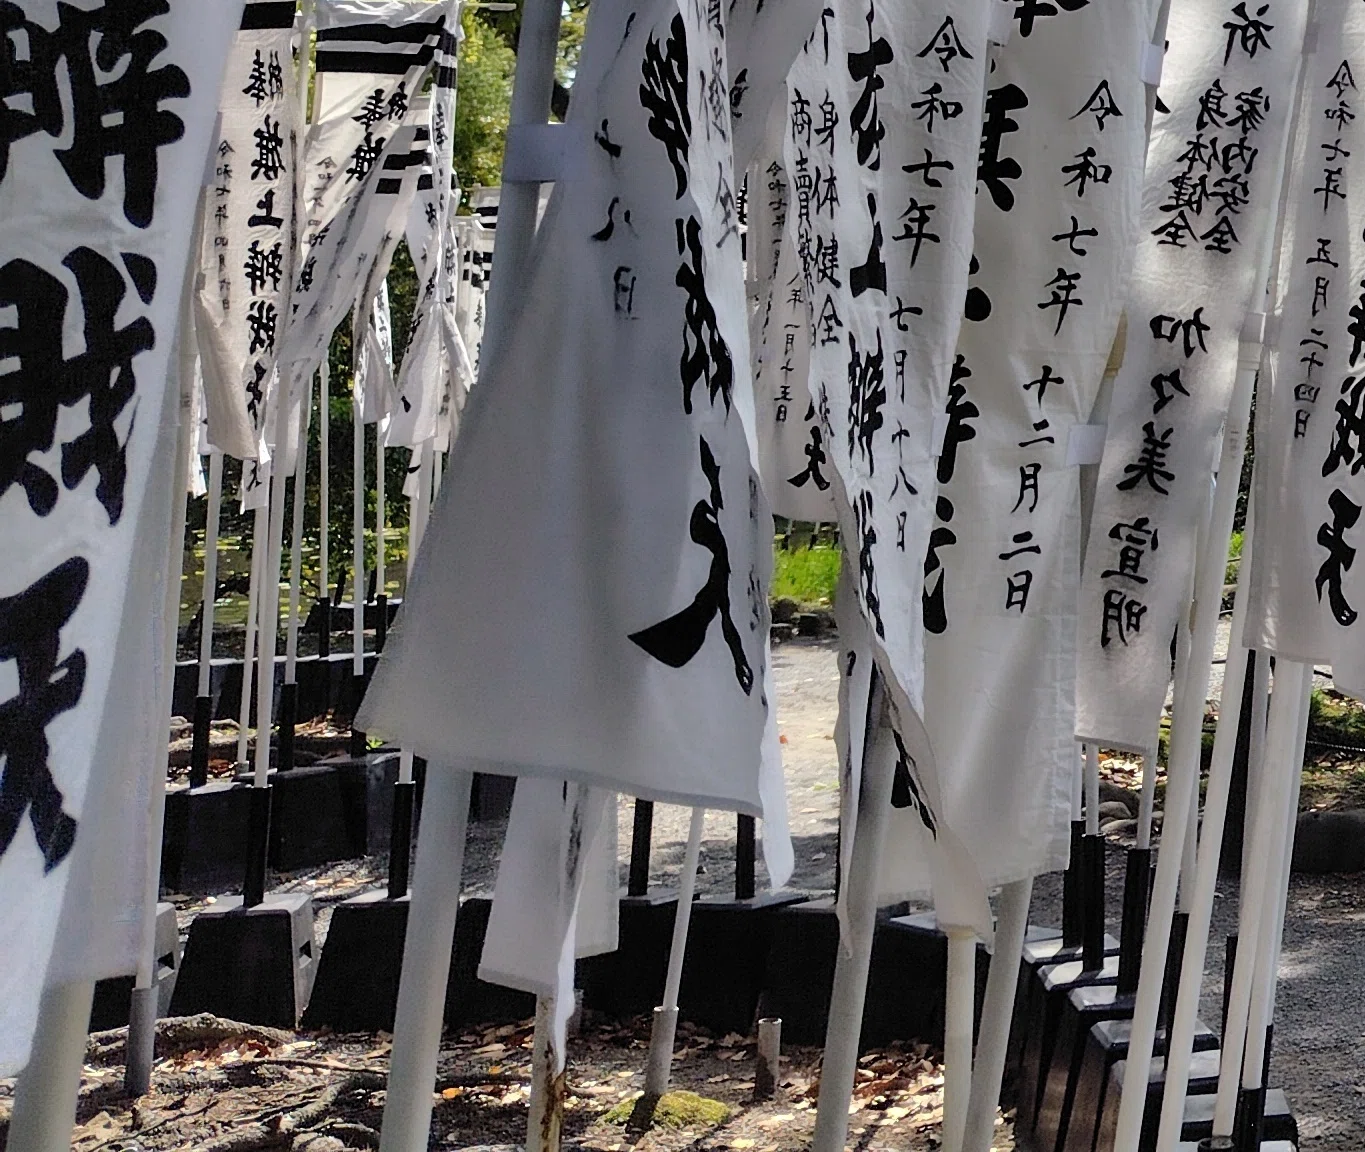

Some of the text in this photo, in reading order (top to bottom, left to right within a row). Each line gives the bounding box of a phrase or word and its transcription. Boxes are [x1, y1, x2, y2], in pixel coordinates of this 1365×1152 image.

[888, 15, 974, 553] 令和七年七月十八日
[997, 79, 1123, 614] 令和七年十二月二日
